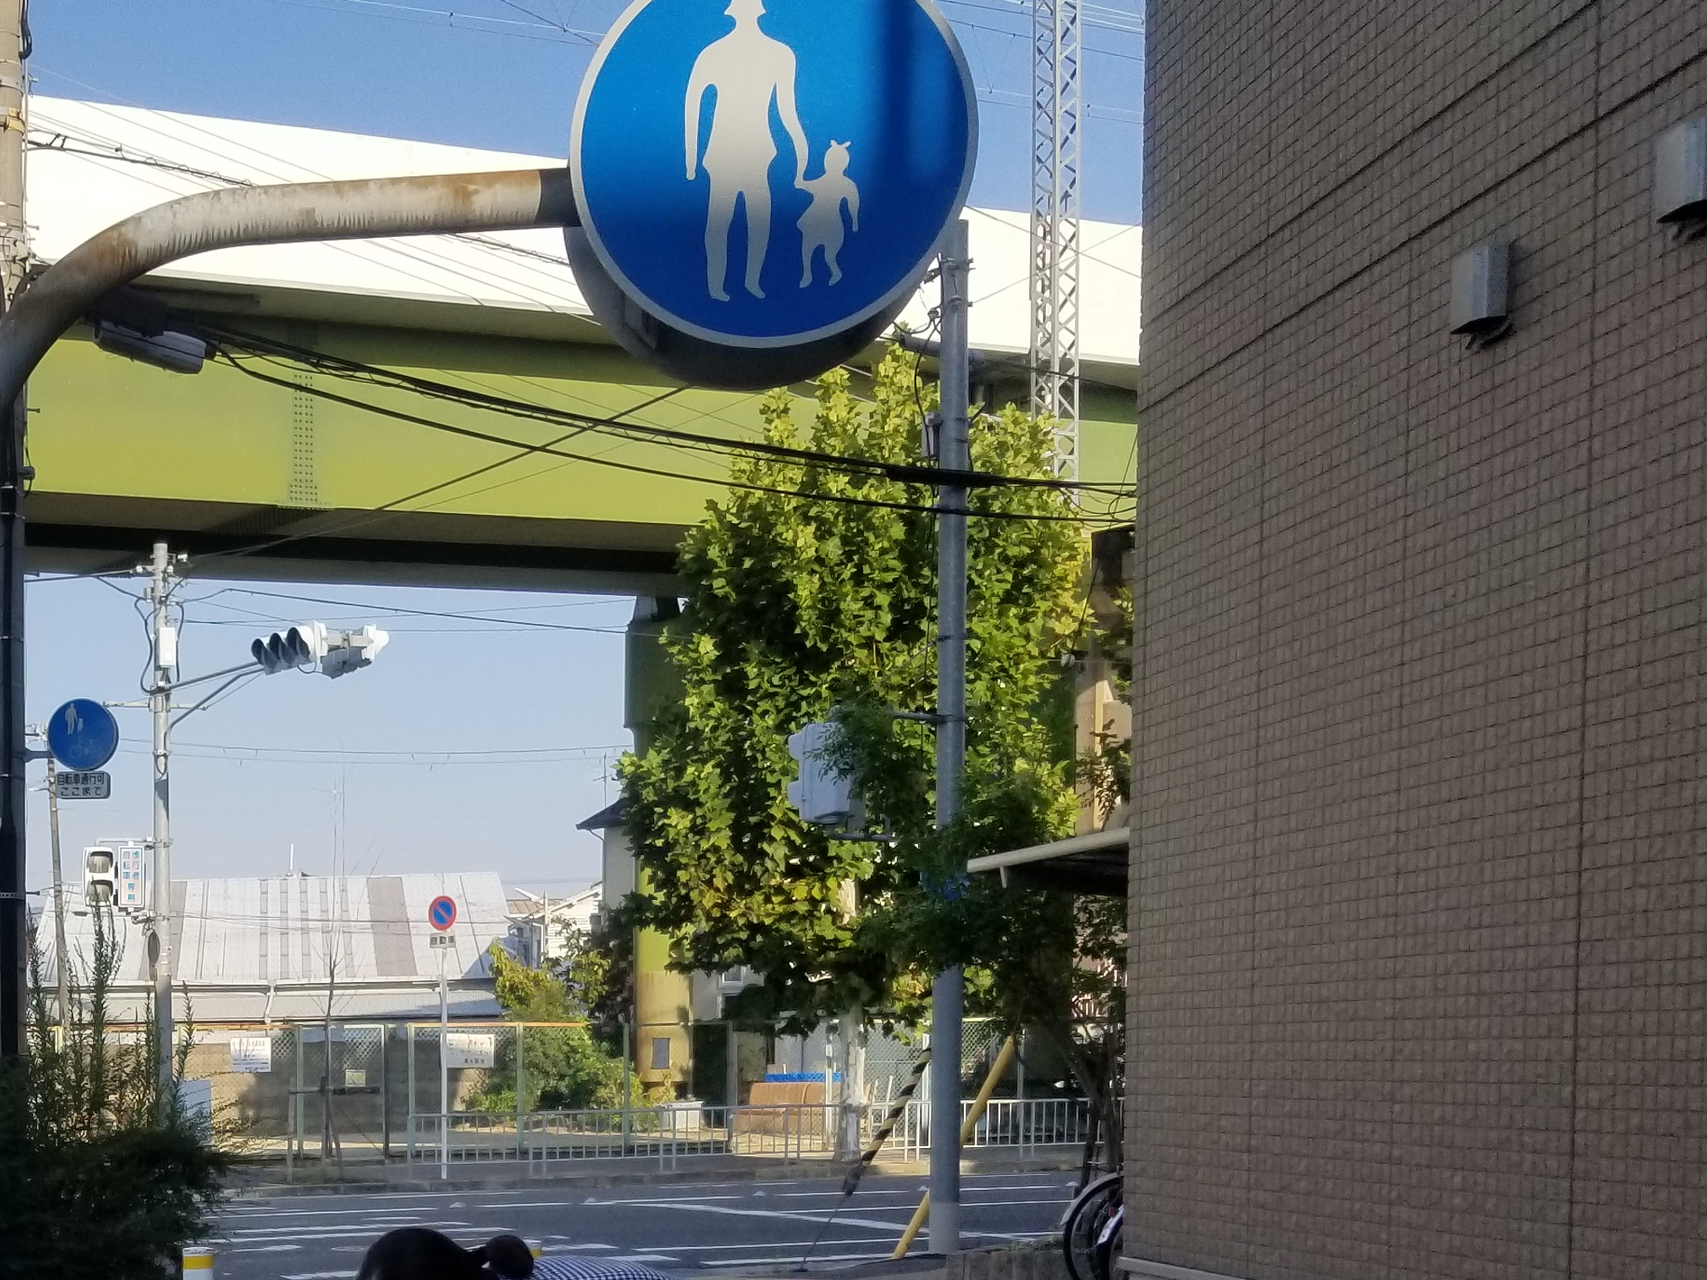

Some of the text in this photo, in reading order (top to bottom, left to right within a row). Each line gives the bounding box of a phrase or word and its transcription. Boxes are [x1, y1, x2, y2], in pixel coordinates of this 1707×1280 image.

[57, 772, 104, 785] 自転車通行可
[60, 786, 102, 796] ここまで
